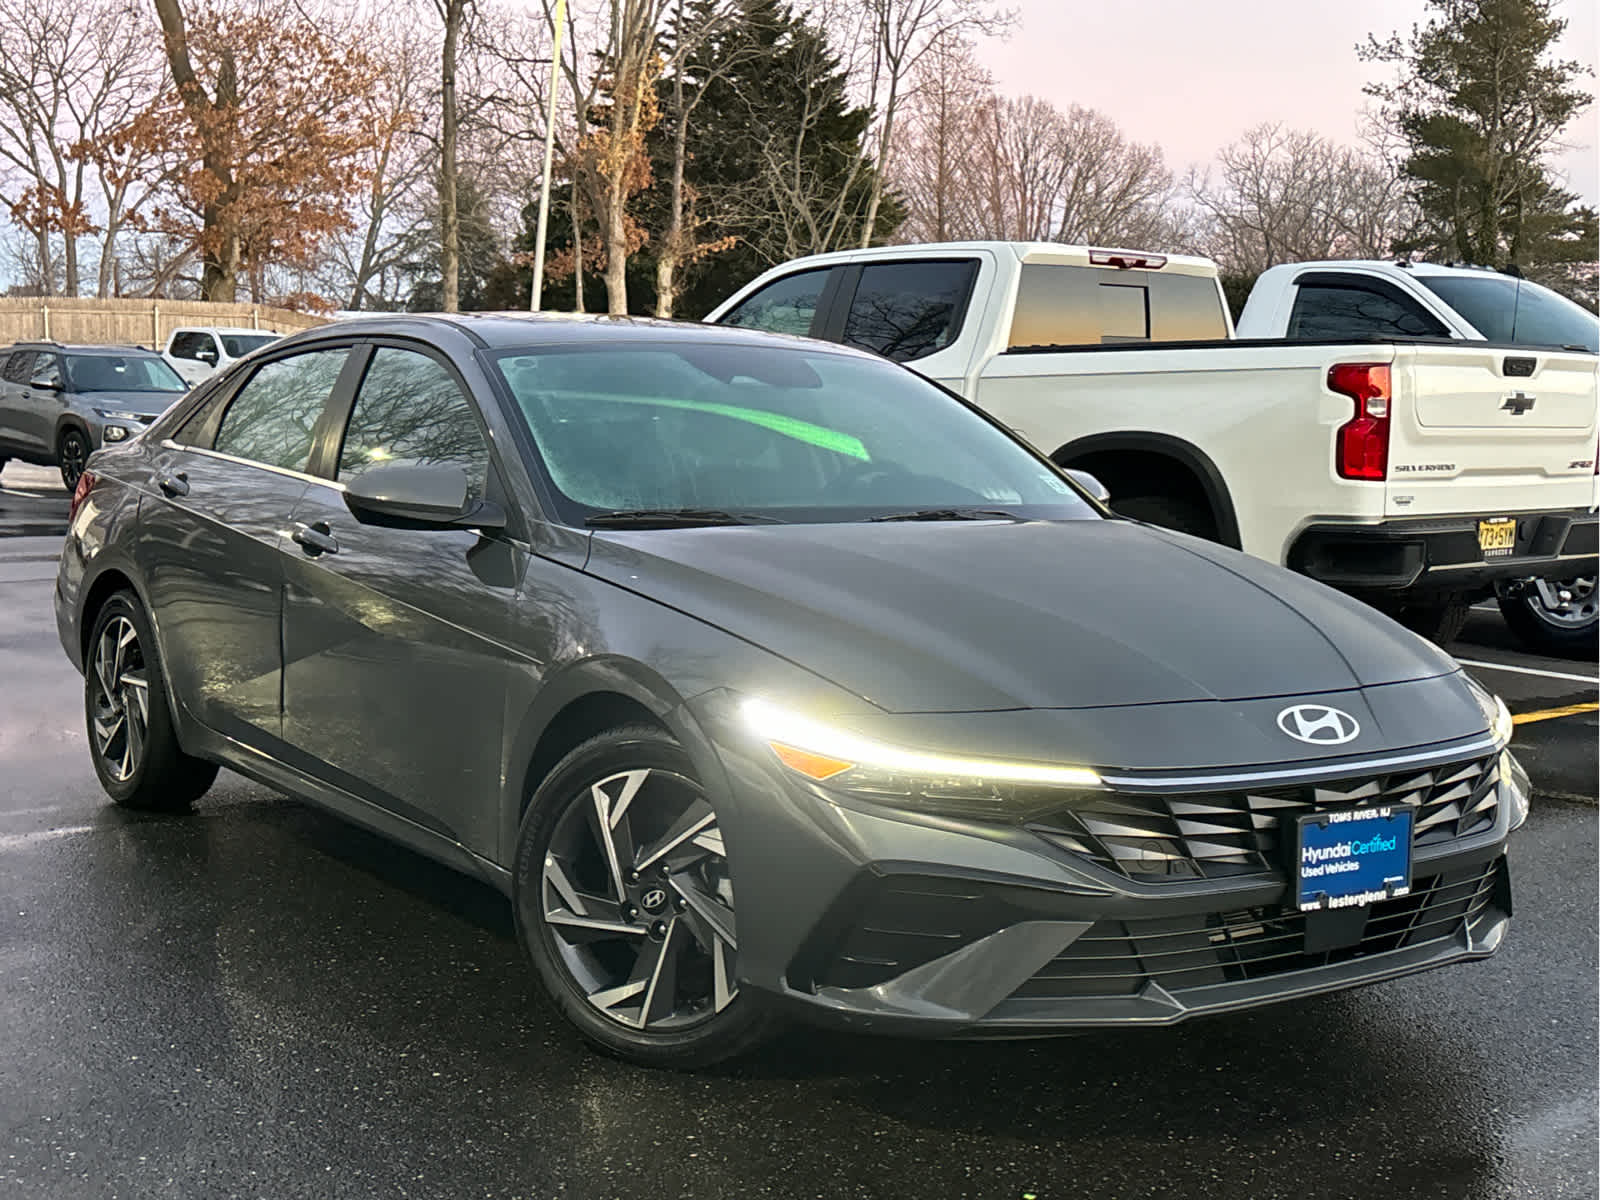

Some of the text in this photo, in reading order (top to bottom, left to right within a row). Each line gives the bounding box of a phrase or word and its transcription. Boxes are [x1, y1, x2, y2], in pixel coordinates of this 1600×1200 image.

[1394, 463, 1456, 473] SILVERADO
[1329, 811, 1352, 823] TOMS
[1380, 807, 1391, 817] NJ
[1301, 861, 1360, 878] Used Vehicles
[1328, 890, 1387, 909] lesterglenn
